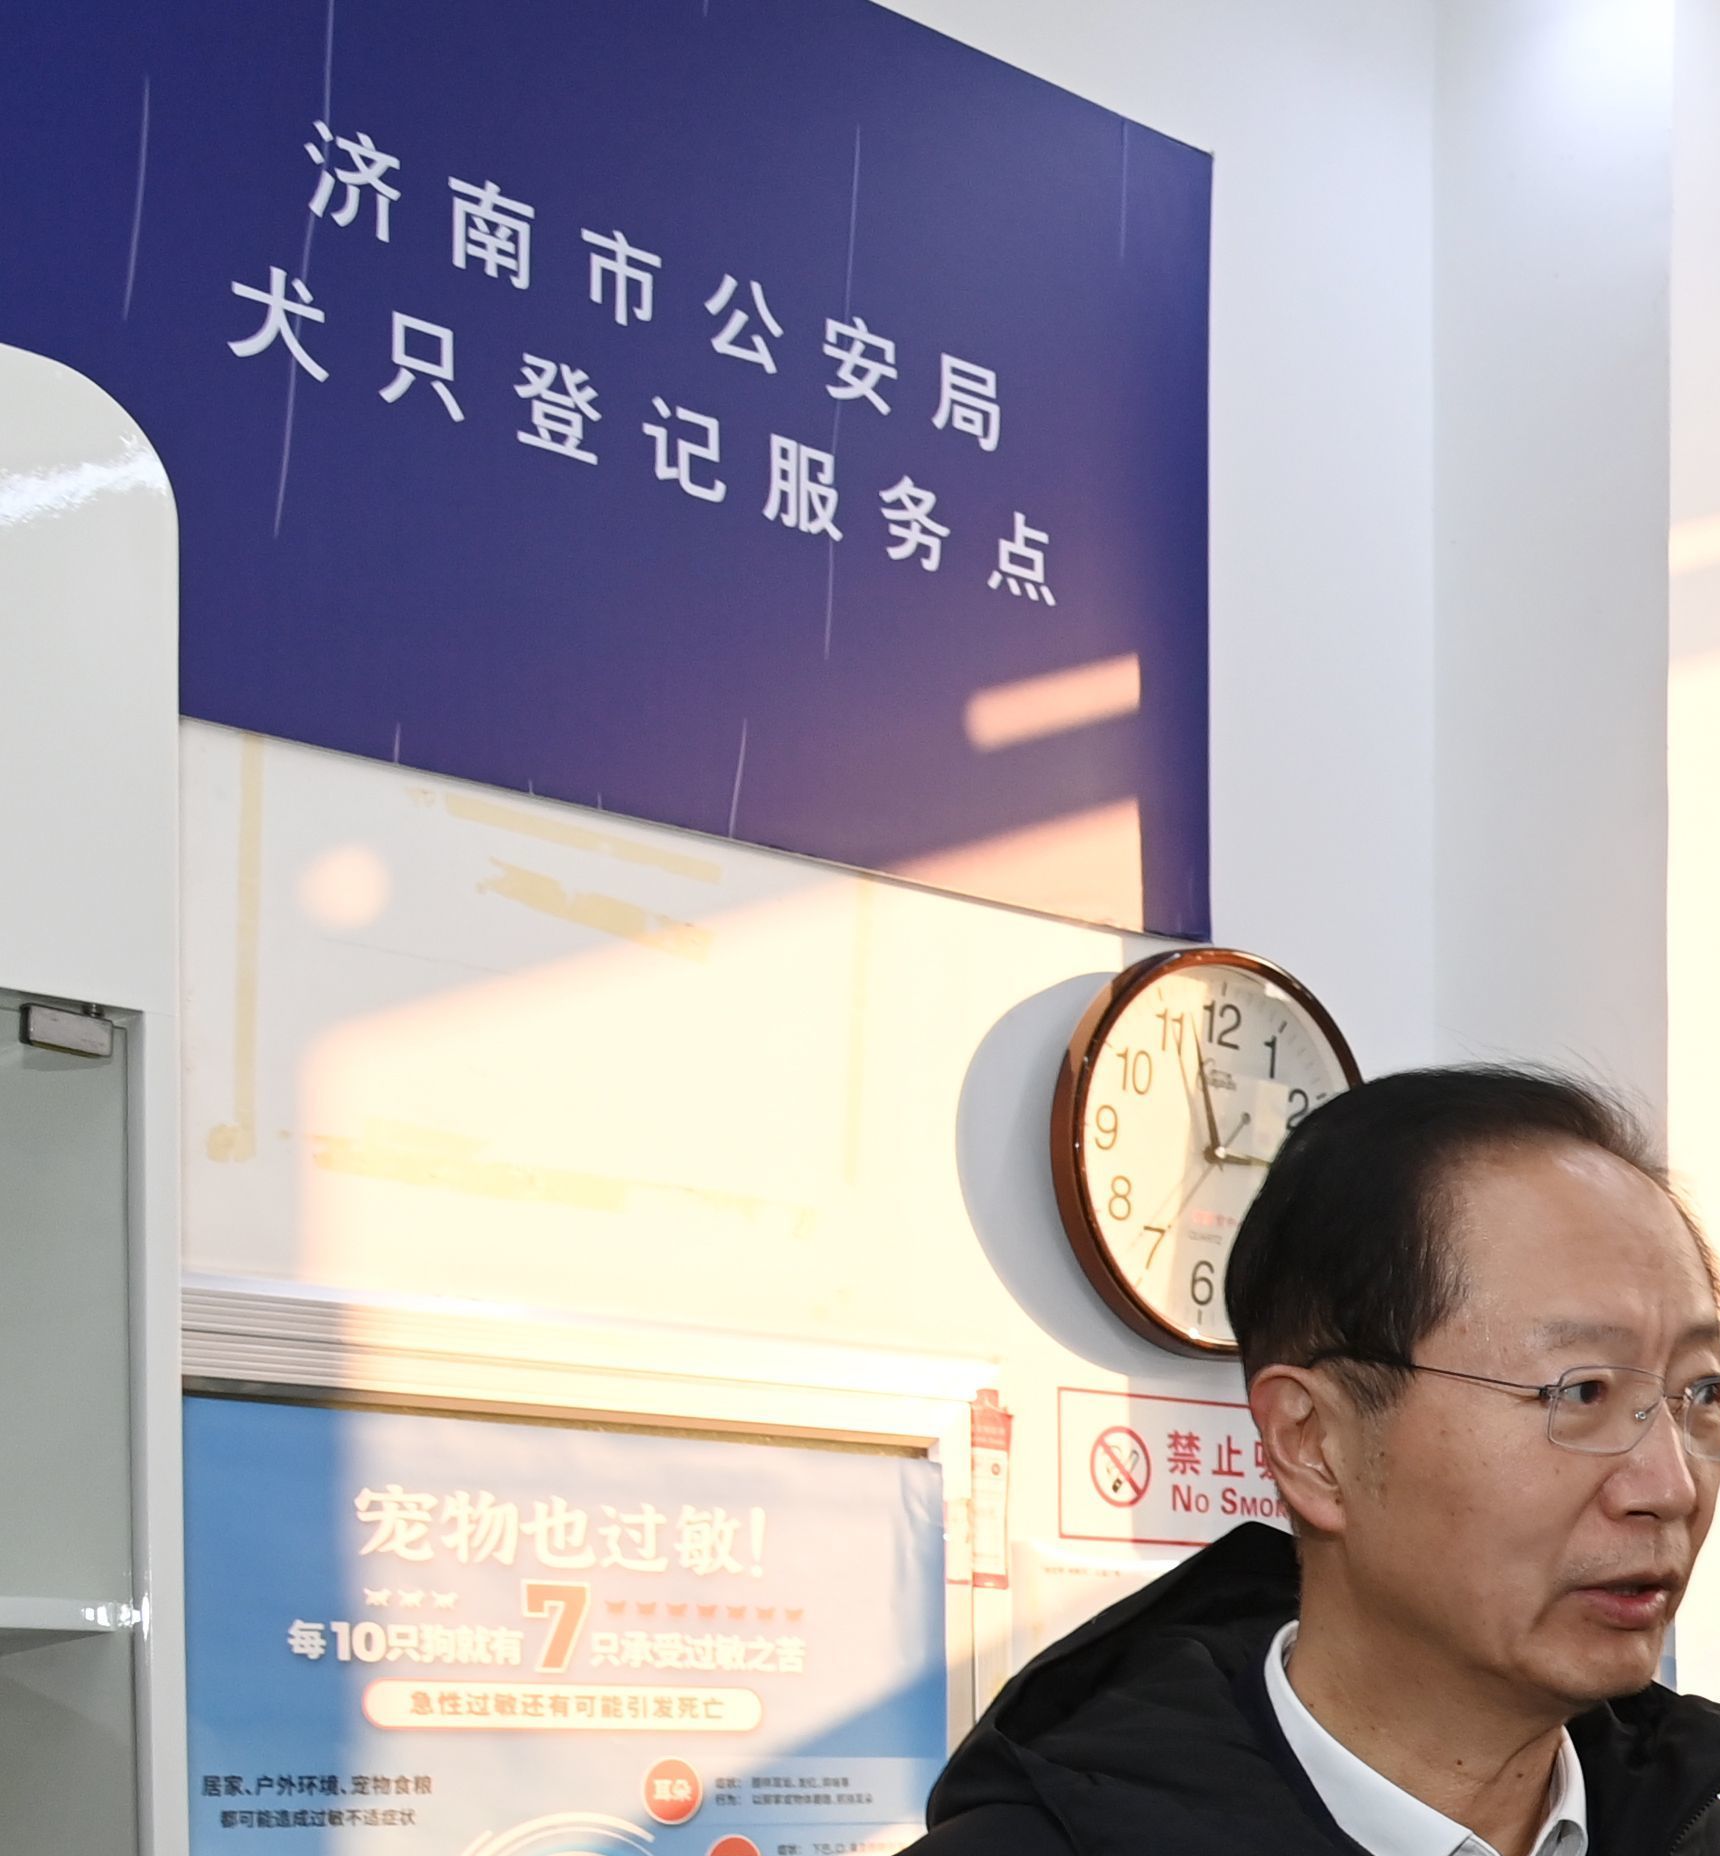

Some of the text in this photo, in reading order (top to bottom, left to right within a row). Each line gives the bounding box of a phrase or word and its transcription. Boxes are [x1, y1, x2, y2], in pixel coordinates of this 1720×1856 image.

[304, 119, 1003, 453] 济南市公安局
[229, 266, 1058, 607] 犬只登记服务点
[1156, 1008, 1184, 1057] 11
[1203, 1000, 1242, 1050] 12
[1116, 1047, 1153, 1096] 10
[1264, 1035, 1277, 1079] 1
[1094, 1105, 1118, 1150] 9
[1286, 1088, 1309, 1130] 2
[1108, 1175, 1132, 1221] 8
[1143, 1225, 1166, 1271] 7
[1190, 1260, 1215, 1305] 6
[353, 1484, 766, 1578] 宠物也过敏！
[410, 1691, 725, 1719] 急性过敏还有可能引发死亡
[653, 1779, 692, 1801] 耳朵
